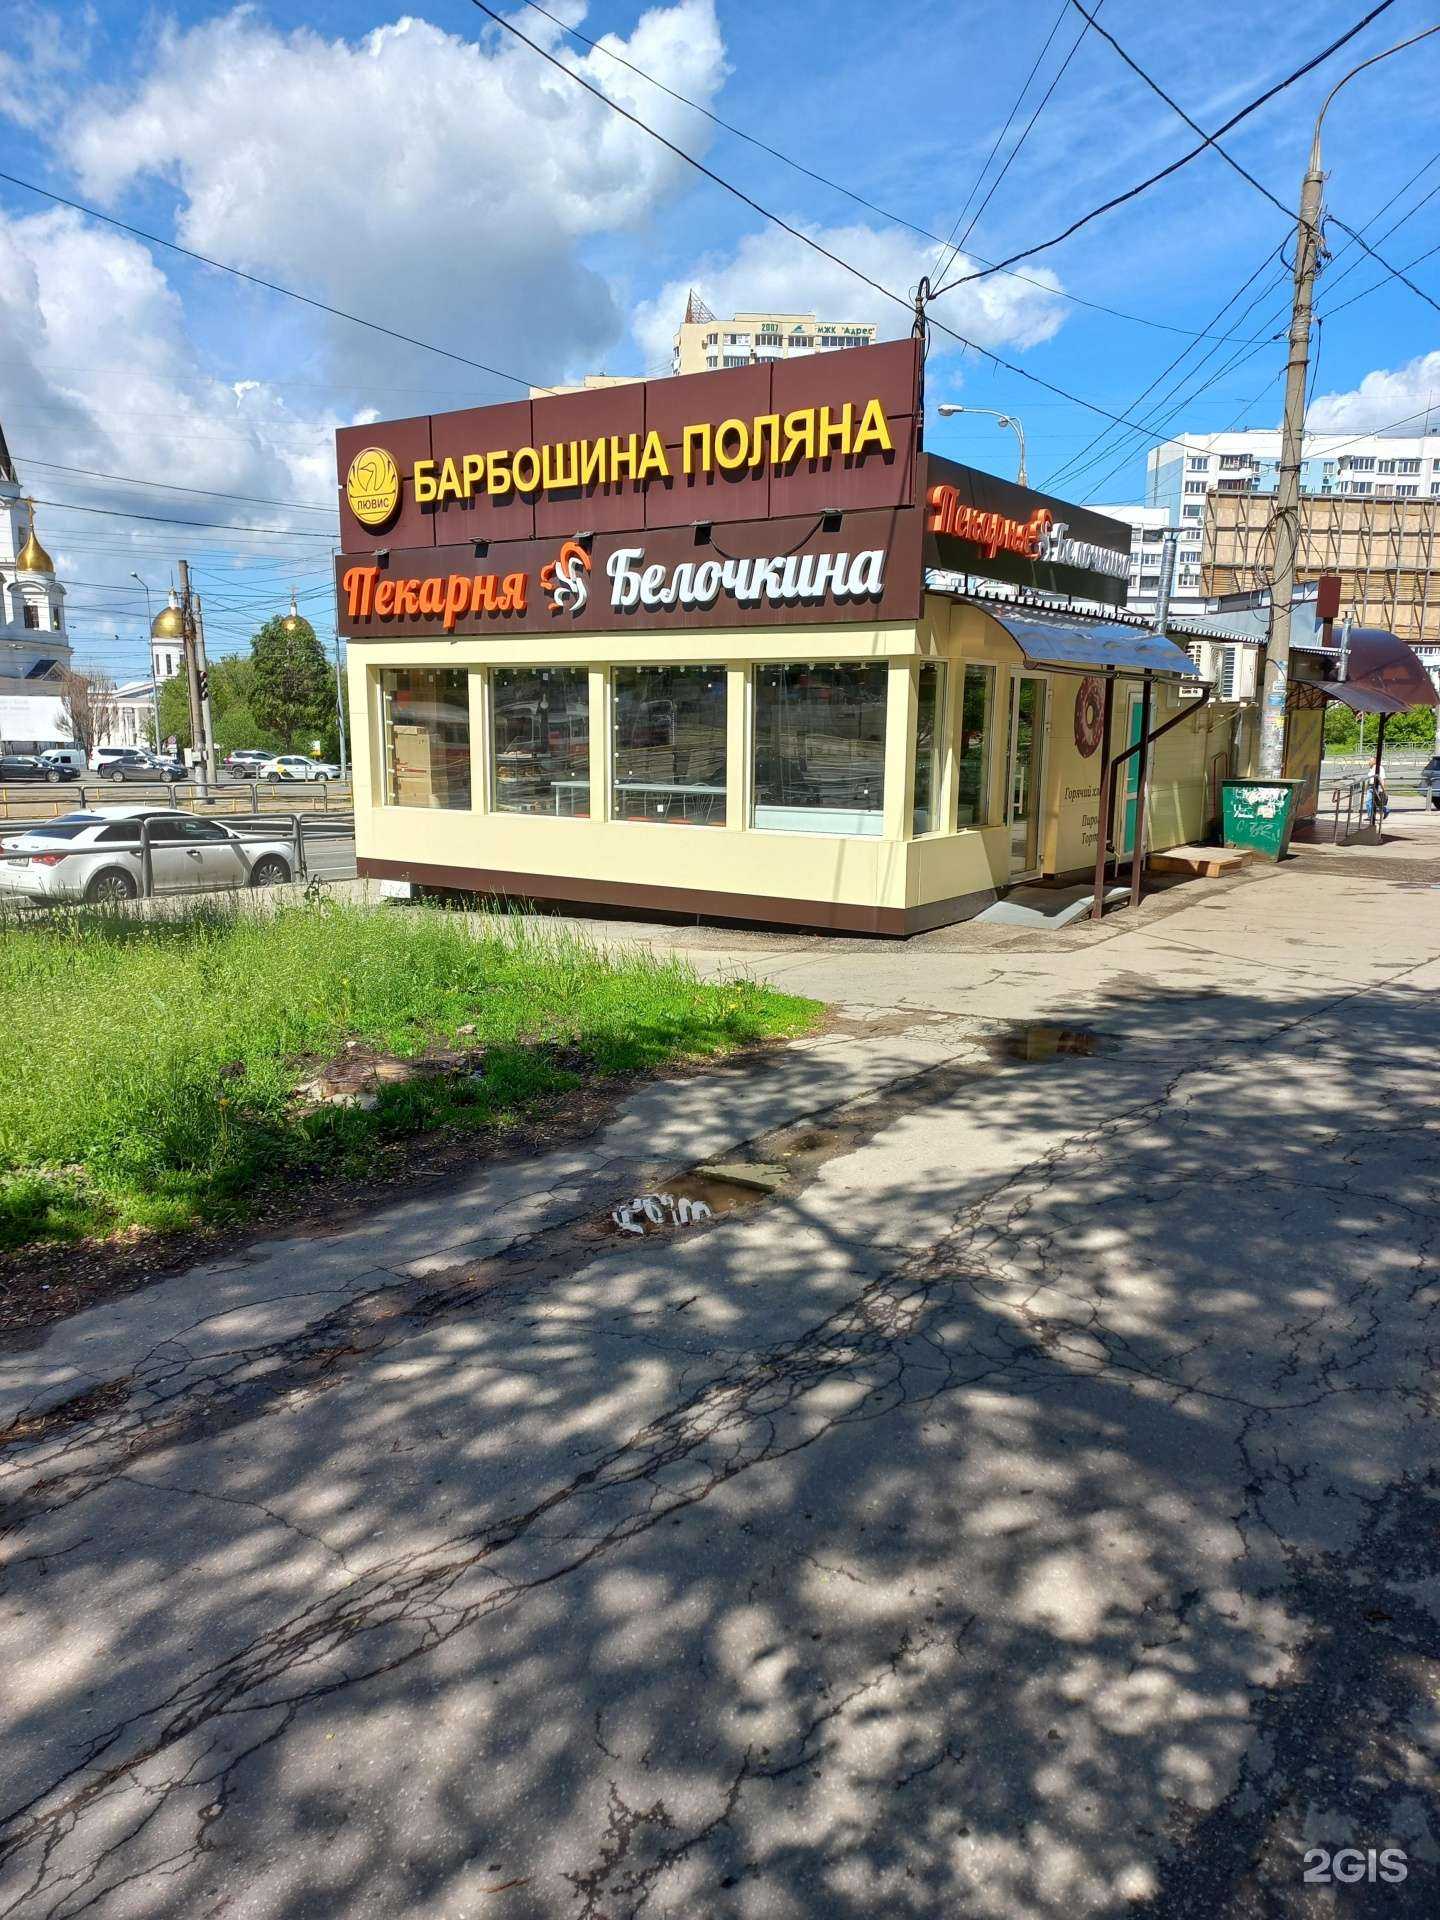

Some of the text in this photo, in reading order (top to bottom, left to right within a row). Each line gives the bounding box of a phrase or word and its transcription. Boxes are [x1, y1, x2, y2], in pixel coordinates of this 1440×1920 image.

[761, 323, 779, 332] 2007
[817, 326, 836, 334] МЖК
[413, 398, 894, 502] БАРБОШИНА ПОЛЯНА
[357, 498, 389, 510] ЛЮВИС
[342, 547, 886, 631] Пекарня Белочкина
